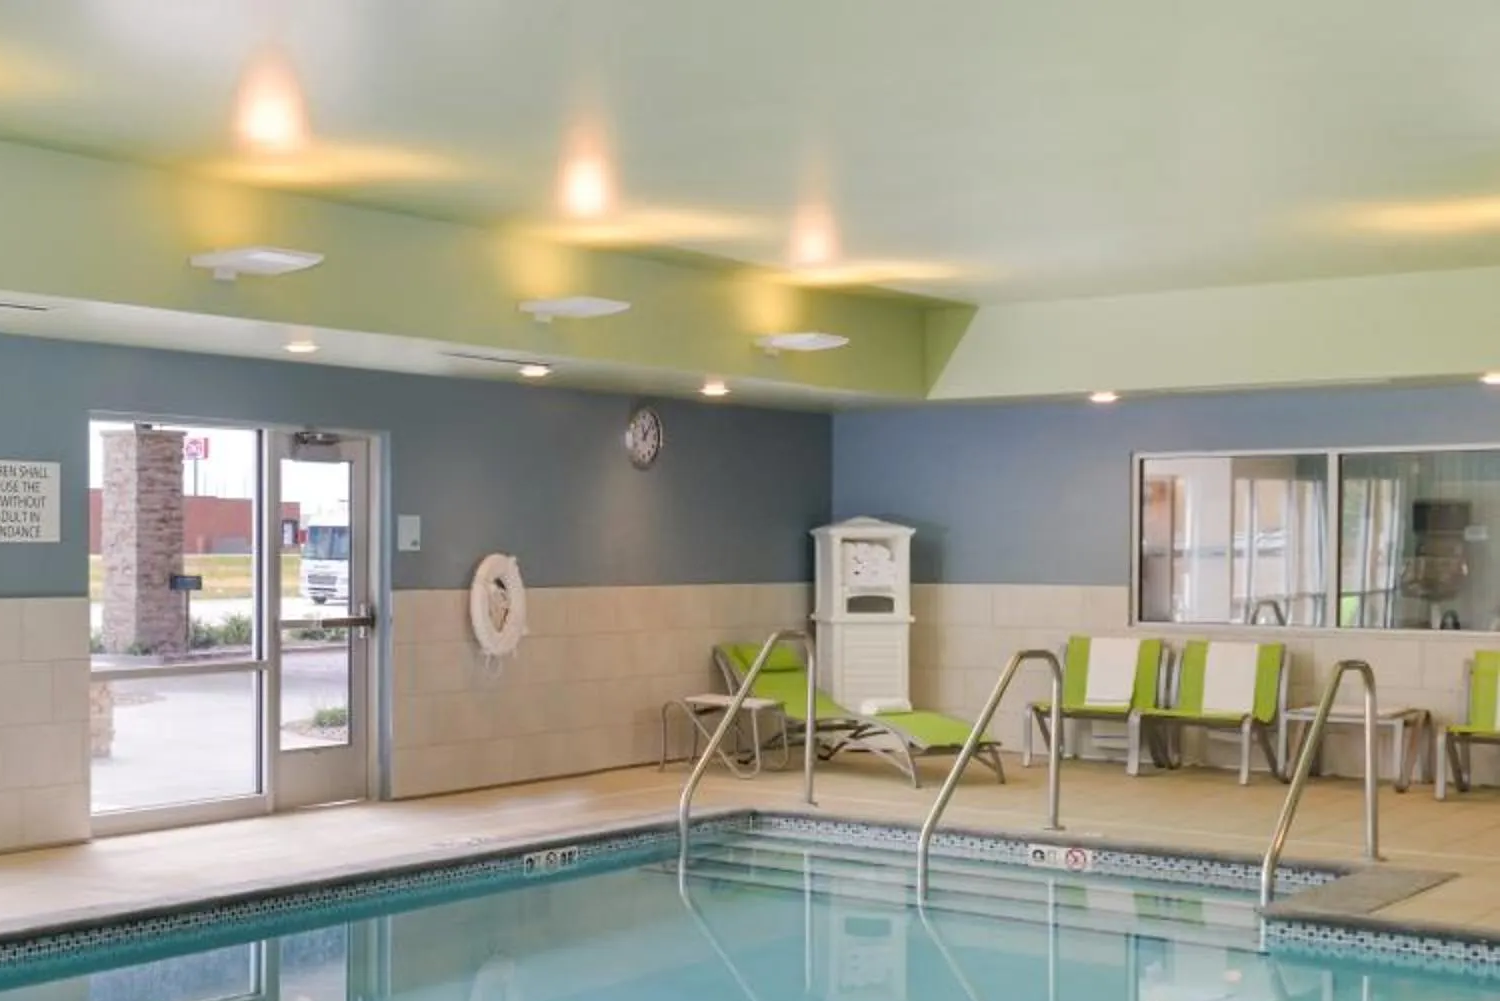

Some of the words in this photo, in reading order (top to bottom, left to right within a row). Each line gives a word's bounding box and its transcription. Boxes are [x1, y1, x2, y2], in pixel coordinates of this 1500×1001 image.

[19, 464, 52, 479] SHALL
[0, 480, 19, 493] USE
[22, 481, 41, 493] THE
[0, 495, 47, 508] WITHOUT
[29, 511, 40, 523] IN
